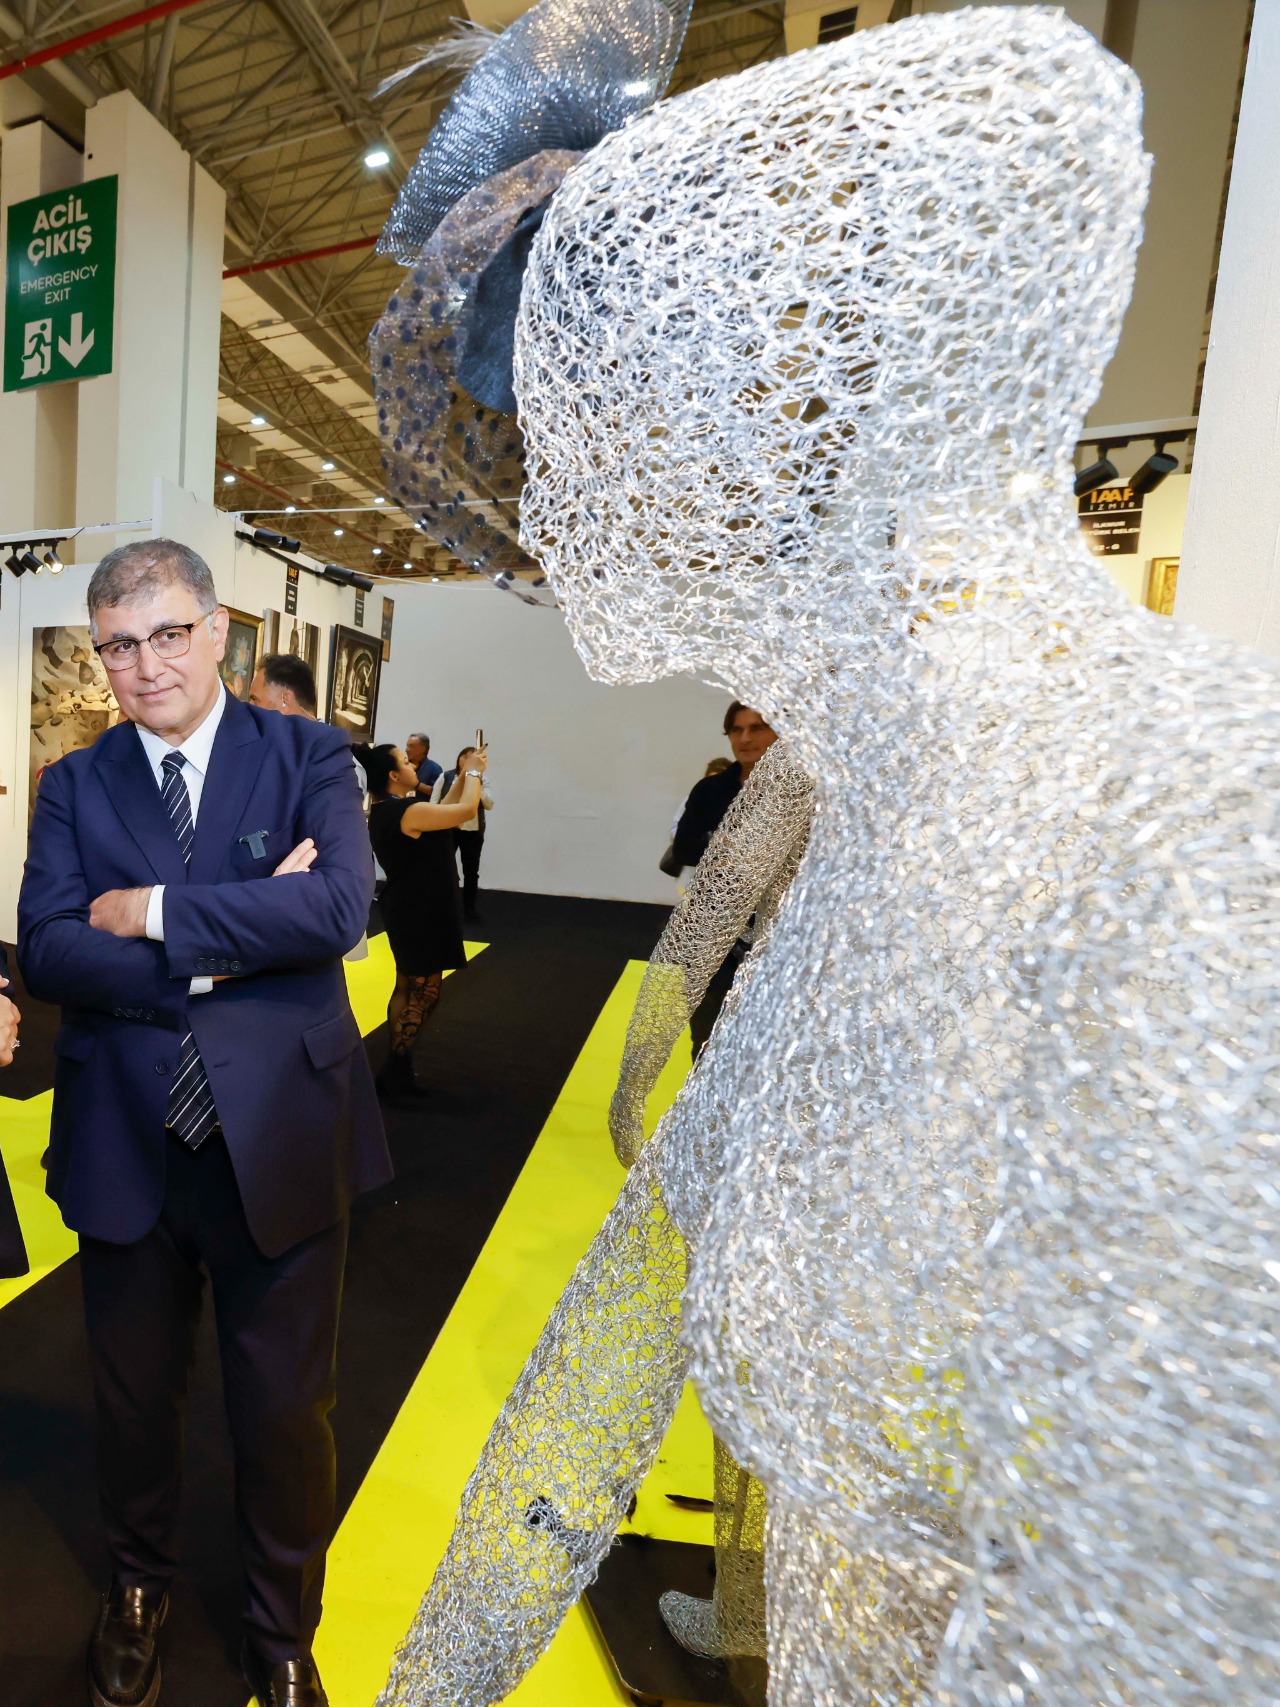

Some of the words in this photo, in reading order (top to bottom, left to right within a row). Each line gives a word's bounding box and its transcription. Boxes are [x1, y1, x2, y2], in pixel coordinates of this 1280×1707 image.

[32, 194, 89, 234] ACİL
[27, 225, 93, 267] ÇIKIŞ
[20, 264, 99, 294] EMERGENCY
[44, 287, 72, 305] EXIT
[1090, 488, 1134, 504] IAAF
